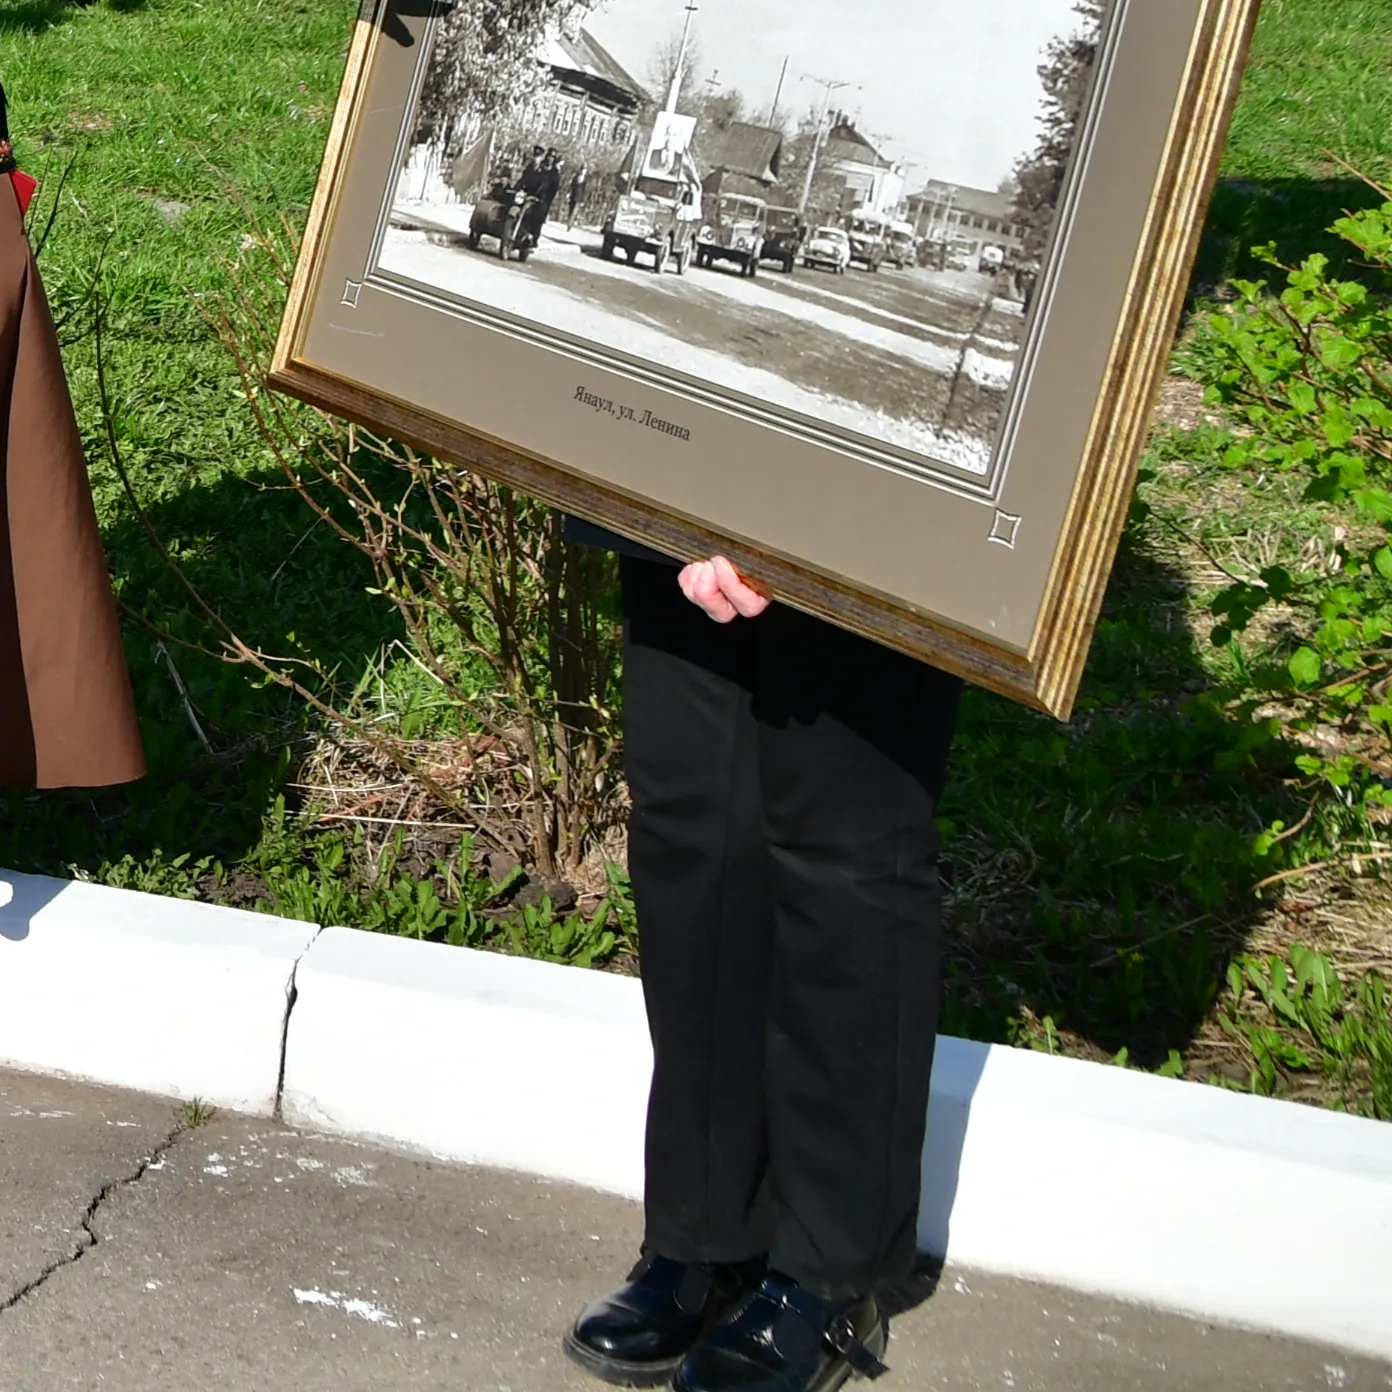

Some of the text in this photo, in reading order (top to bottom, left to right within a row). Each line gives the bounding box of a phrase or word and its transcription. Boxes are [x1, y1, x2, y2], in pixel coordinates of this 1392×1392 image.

[573, 385, 691, 442] Янаул, ул. Ленина
